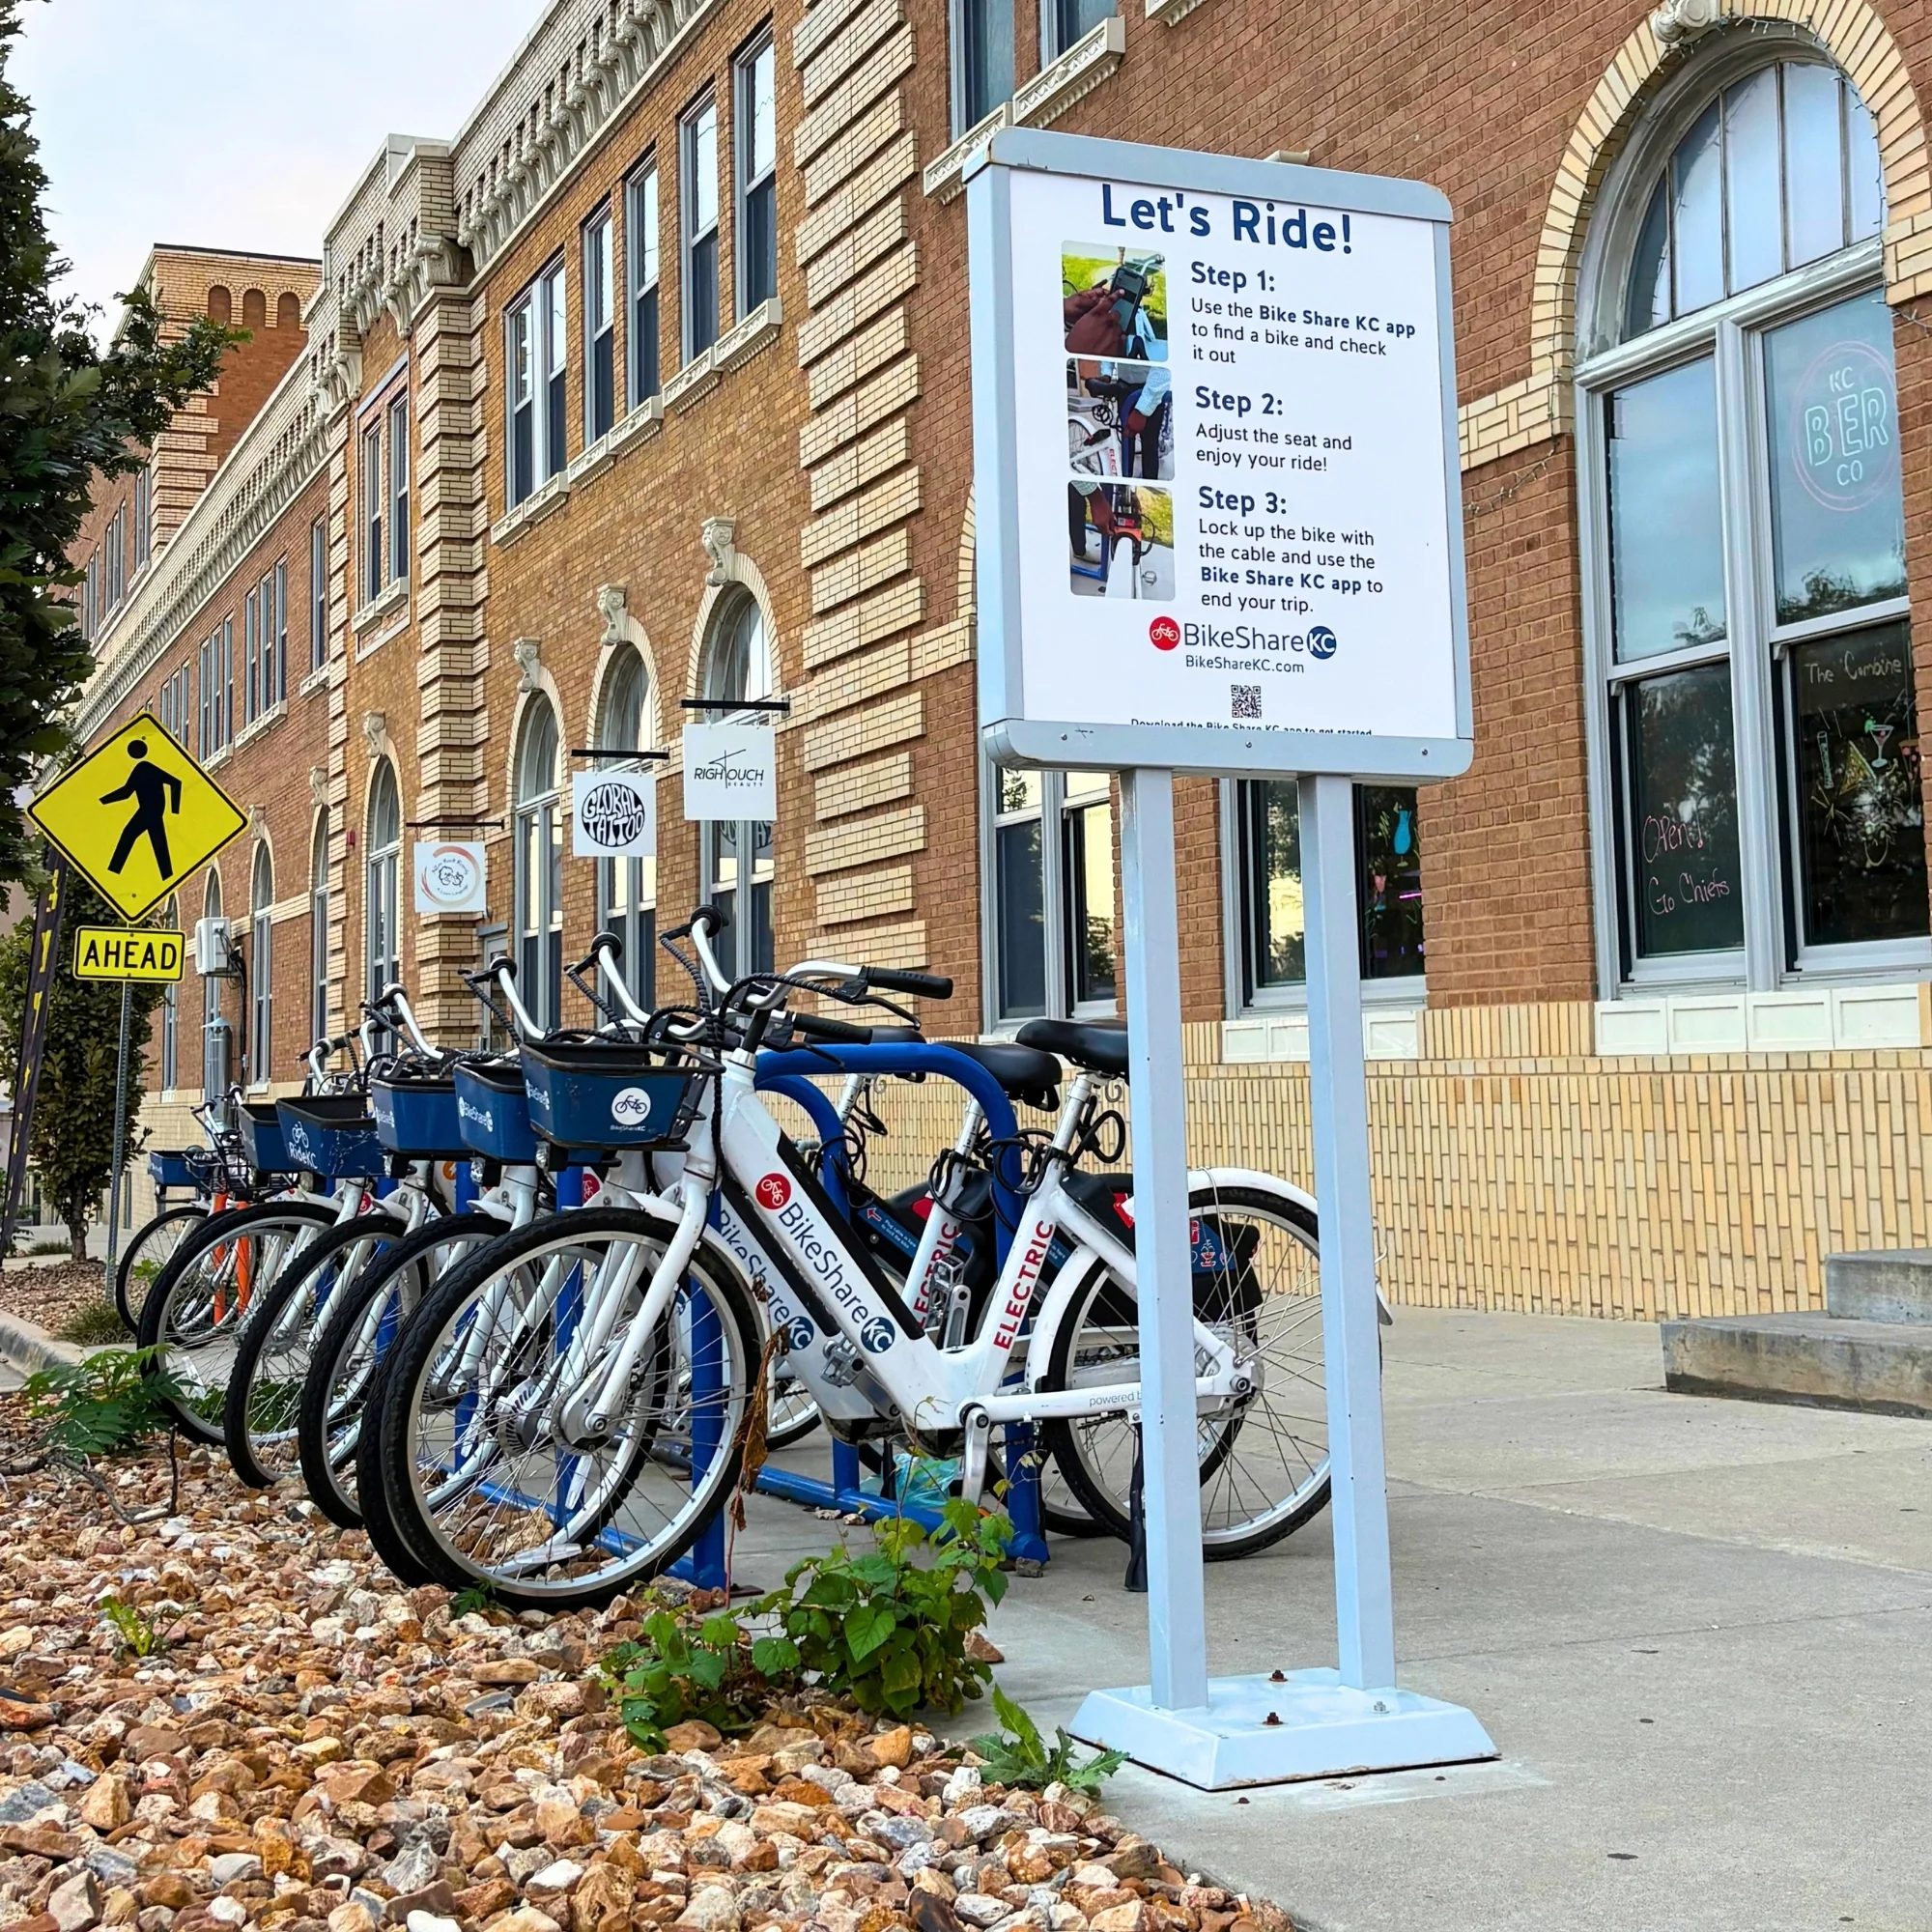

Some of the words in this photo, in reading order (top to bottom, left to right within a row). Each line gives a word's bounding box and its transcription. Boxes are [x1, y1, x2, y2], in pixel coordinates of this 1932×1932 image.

[1101, 183, 1211, 238] Let's
[1232, 199, 1352, 255] Ride!
[1190, 261, 1247, 295] Step
[1257, 270, 1275, 293] 1:
[1191, 297, 1223, 315] Use
[1227, 301, 1253, 319] the
[1259, 304, 1297, 324] Bike
[1302, 309, 1350, 329] Share
[1355, 315, 1380, 332] KC
[1385, 322, 1416, 339] app
[1191, 323, 1208, 337] to
[1213, 323, 1244, 341] find
[1250, 330, 1259, 343] a
[1264, 328, 1299, 347] bike
[1304, 335, 1334, 351] and
[1339, 337, 1386, 356] check
[1193, 344, 1204, 360] it
[1208, 350, 1236, 364] out
[1829, 366, 1856, 393] KC
[1195, 385, 1252, 418] Step
[1261, 392, 1283, 416] 2:
[1195, 422, 1249, 443] Adjust
[1253, 428, 1279, 444] the
[1284, 434, 1318, 448] seat
[1322, 435, 1352, 451] and
[1196, 447, 1242, 469] enjoy
[1247, 454, 1286, 469] your
[1291, 455, 1327, 471] ride!
[1198, 485, 1256, 518] Step
[1264, 492, 1287, 515] 3:
[1199, 518, 1238, 536] Lock
[1244, 526, 1265, 542] up
[1269, 524, 1296, 541] the
[1301, 526, 1336, 543] bike
[1341, 529, 1375, 547] with
[1198, 542, 1225, 559] the
[1231, 546, 1276, 563] cable
[1281, 550, 1312, 565] and
[1317, 554, 1346, 568] use
[1350, 553, 1376, 570] the
[1201, 566, 1239, 583] Bike
[1245, 569, 1294, 587] Share
[1300, 573, 1325, 589] KC
[1331, 579, 1362, 596] app
[1366, 580, 1383, 593] to
[1201, 591, 1232, 608] end
[1237, 596, 1276, 612] your
[1280, 597, 1314, 616] trip.
[1185, 654, 1304, 673] BikeShareKC.com
[1804, 662, 1833, 684] The
[582, 783, 643, 818] GLOBAL
[582, 811, 644, 847] TATTOO
[1648, 876, 1675, 915] Go
[1679, 868, 1730, 903] Chiefs
[82, 939, 177, 970] AHEAD
[289, 1142, 319, 1170] RideKC
[994, 1220, 1054, 1350] ELECTRIC
[1089, 1391, 1134, 1406] powered
